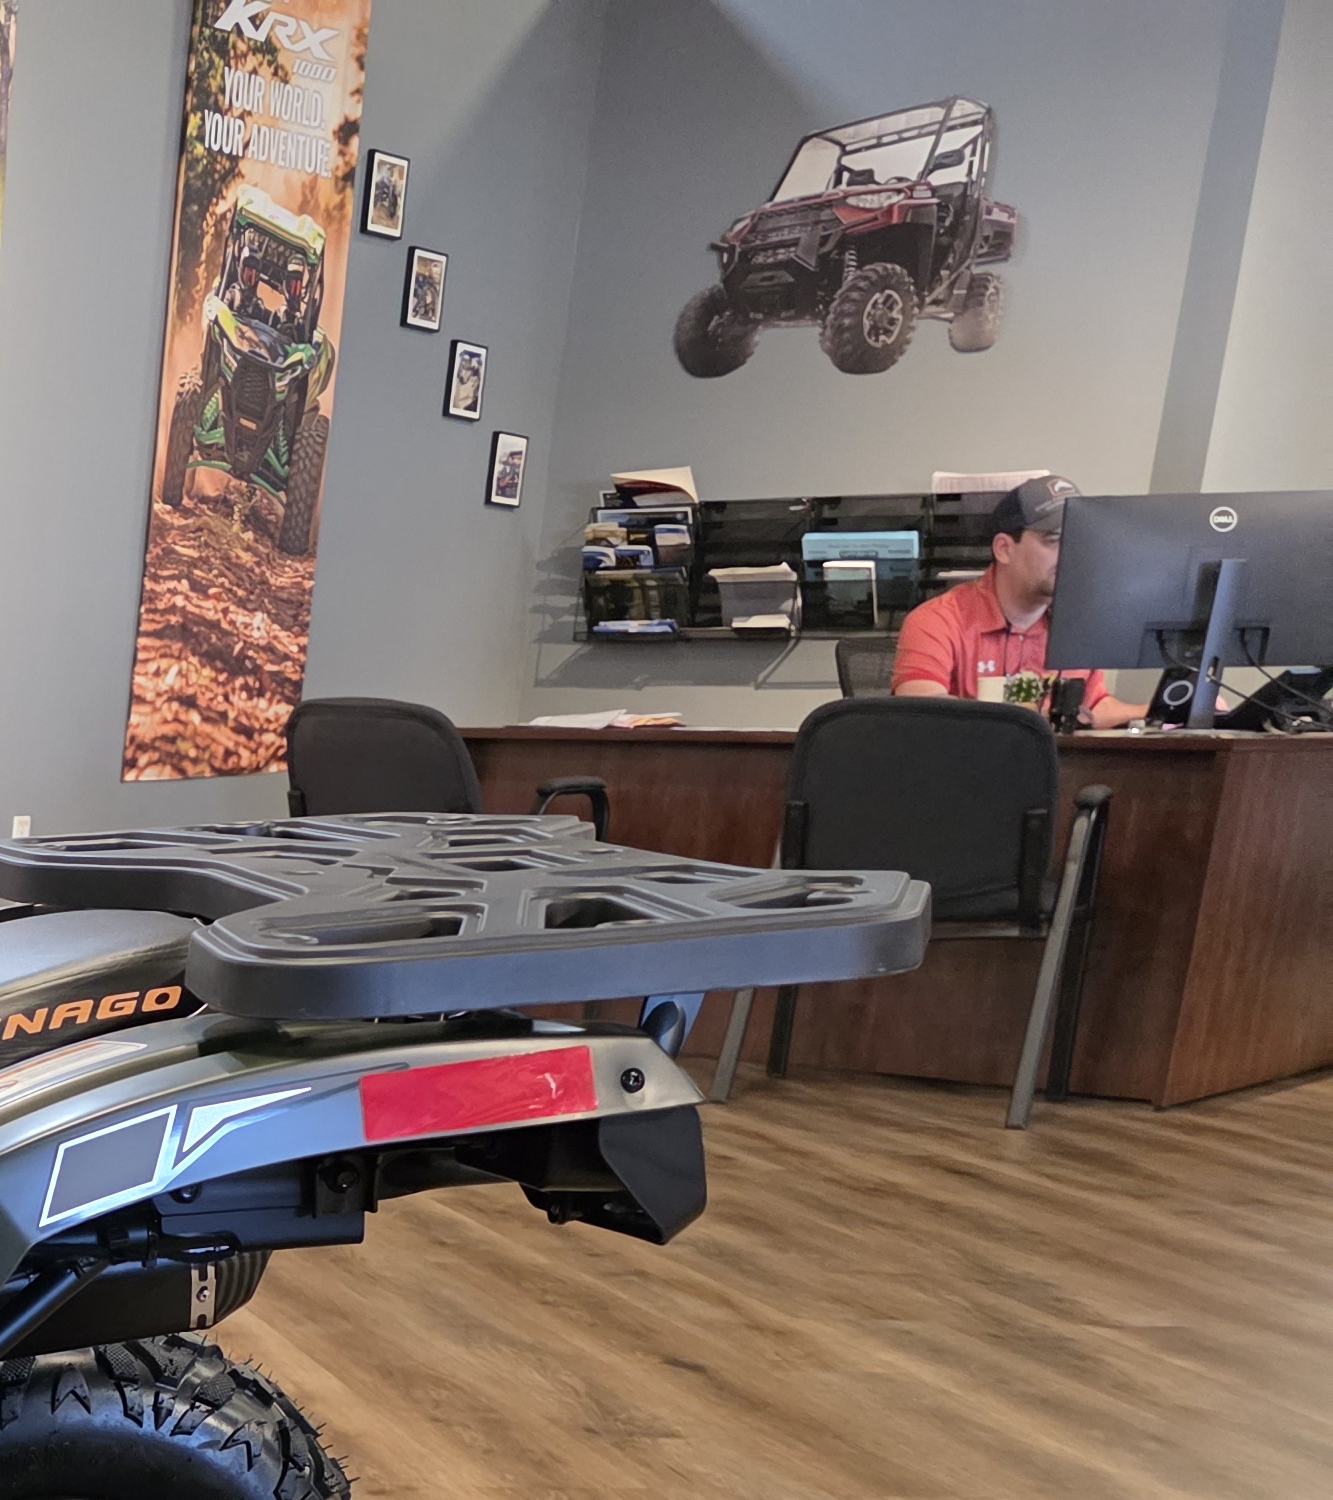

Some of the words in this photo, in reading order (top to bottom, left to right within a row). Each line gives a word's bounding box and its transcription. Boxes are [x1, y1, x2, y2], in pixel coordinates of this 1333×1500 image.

[214, 0, 340, 61] KRX
[292, 58, 337, 82] 1000
[224, 66, 265, 115] YOUR
[270, 79, 326, 130] WORLD.
[204, 109, 244, 157] YOUR
